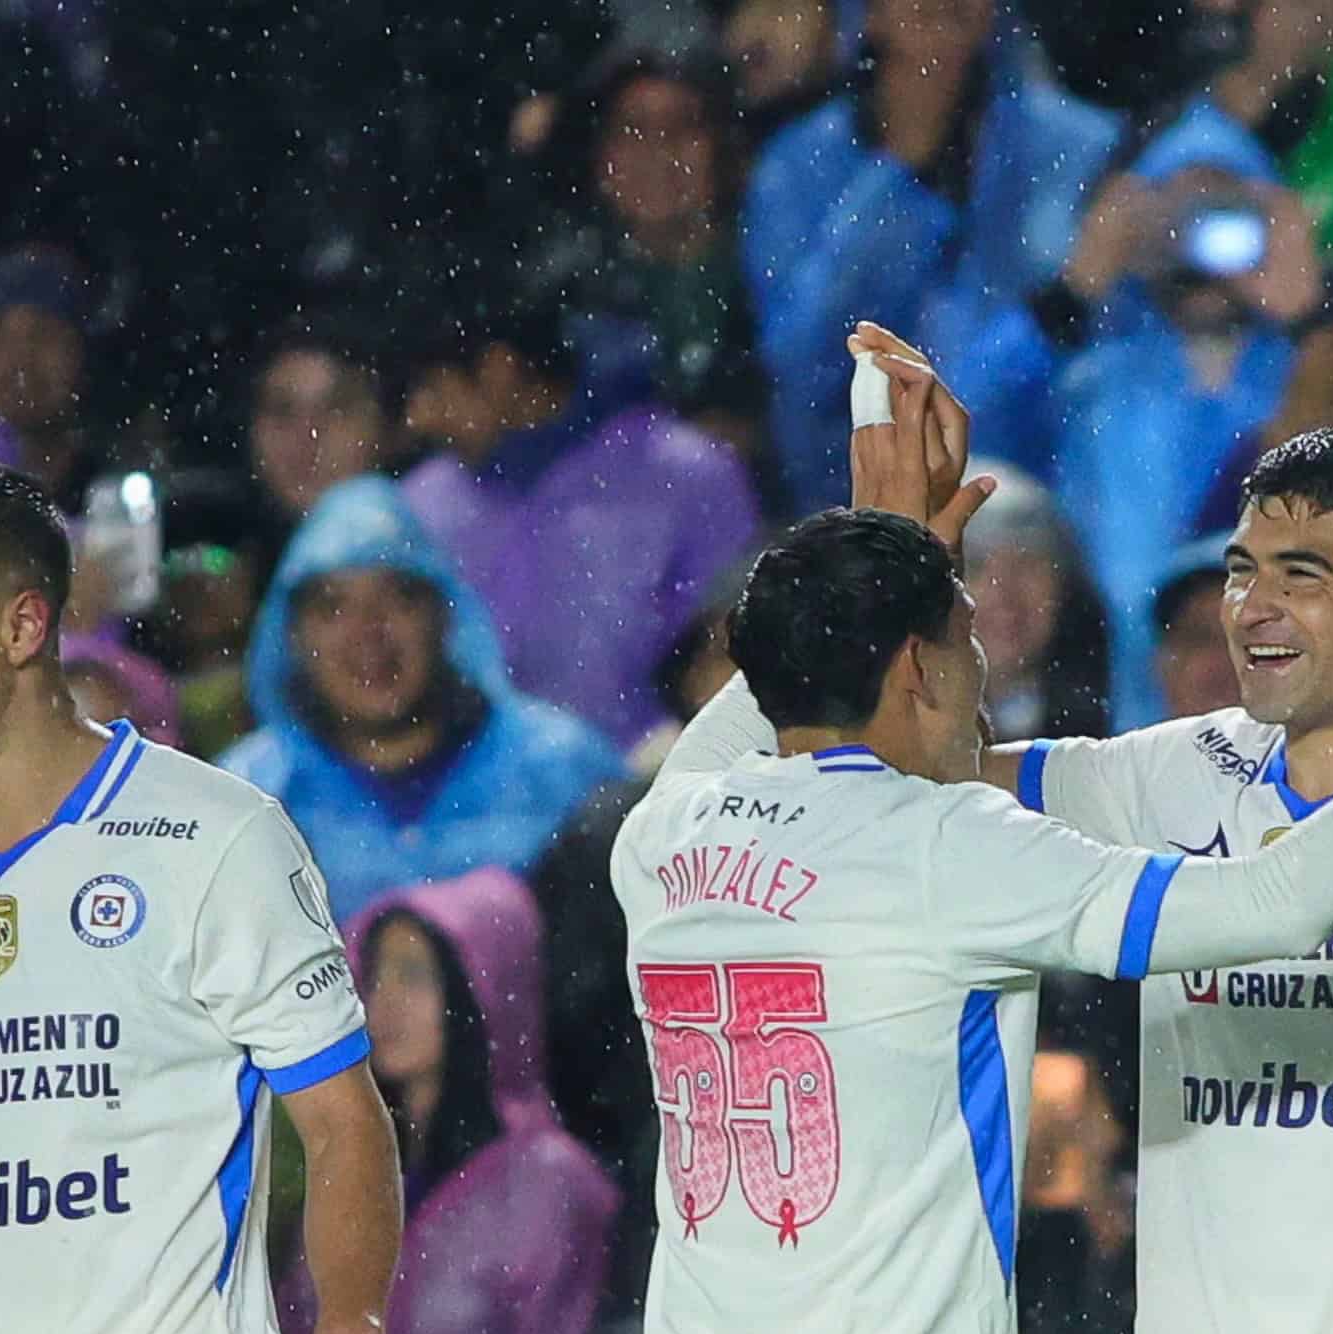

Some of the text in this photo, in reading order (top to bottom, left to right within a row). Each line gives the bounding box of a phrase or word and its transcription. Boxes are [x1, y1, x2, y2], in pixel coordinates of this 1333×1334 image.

[98, 817, 201, 840] novibet
[1227, 972, 1306, 1008] CRUZ
[31, 1063, 120, 1101] AZUL
[637, 963, 841, 1228] 55
